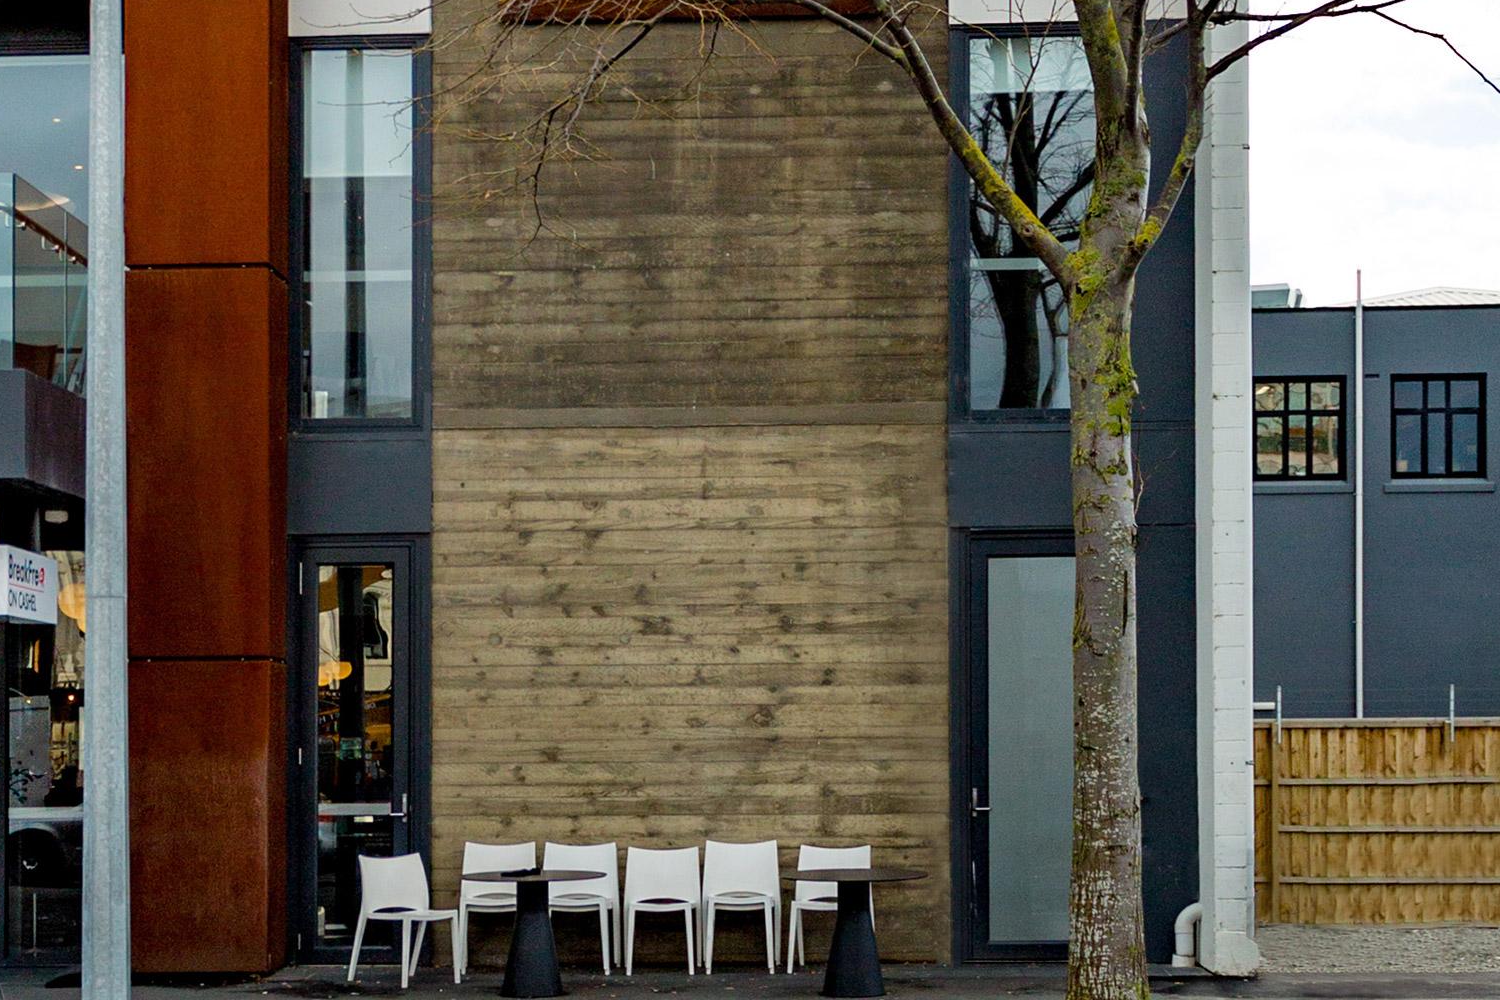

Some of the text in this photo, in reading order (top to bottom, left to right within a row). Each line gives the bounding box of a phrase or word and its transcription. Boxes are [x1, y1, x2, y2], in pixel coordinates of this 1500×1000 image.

[8, 553, 45, 586] BreakFree
[8, 589, 37, 612] ON CASHEL
